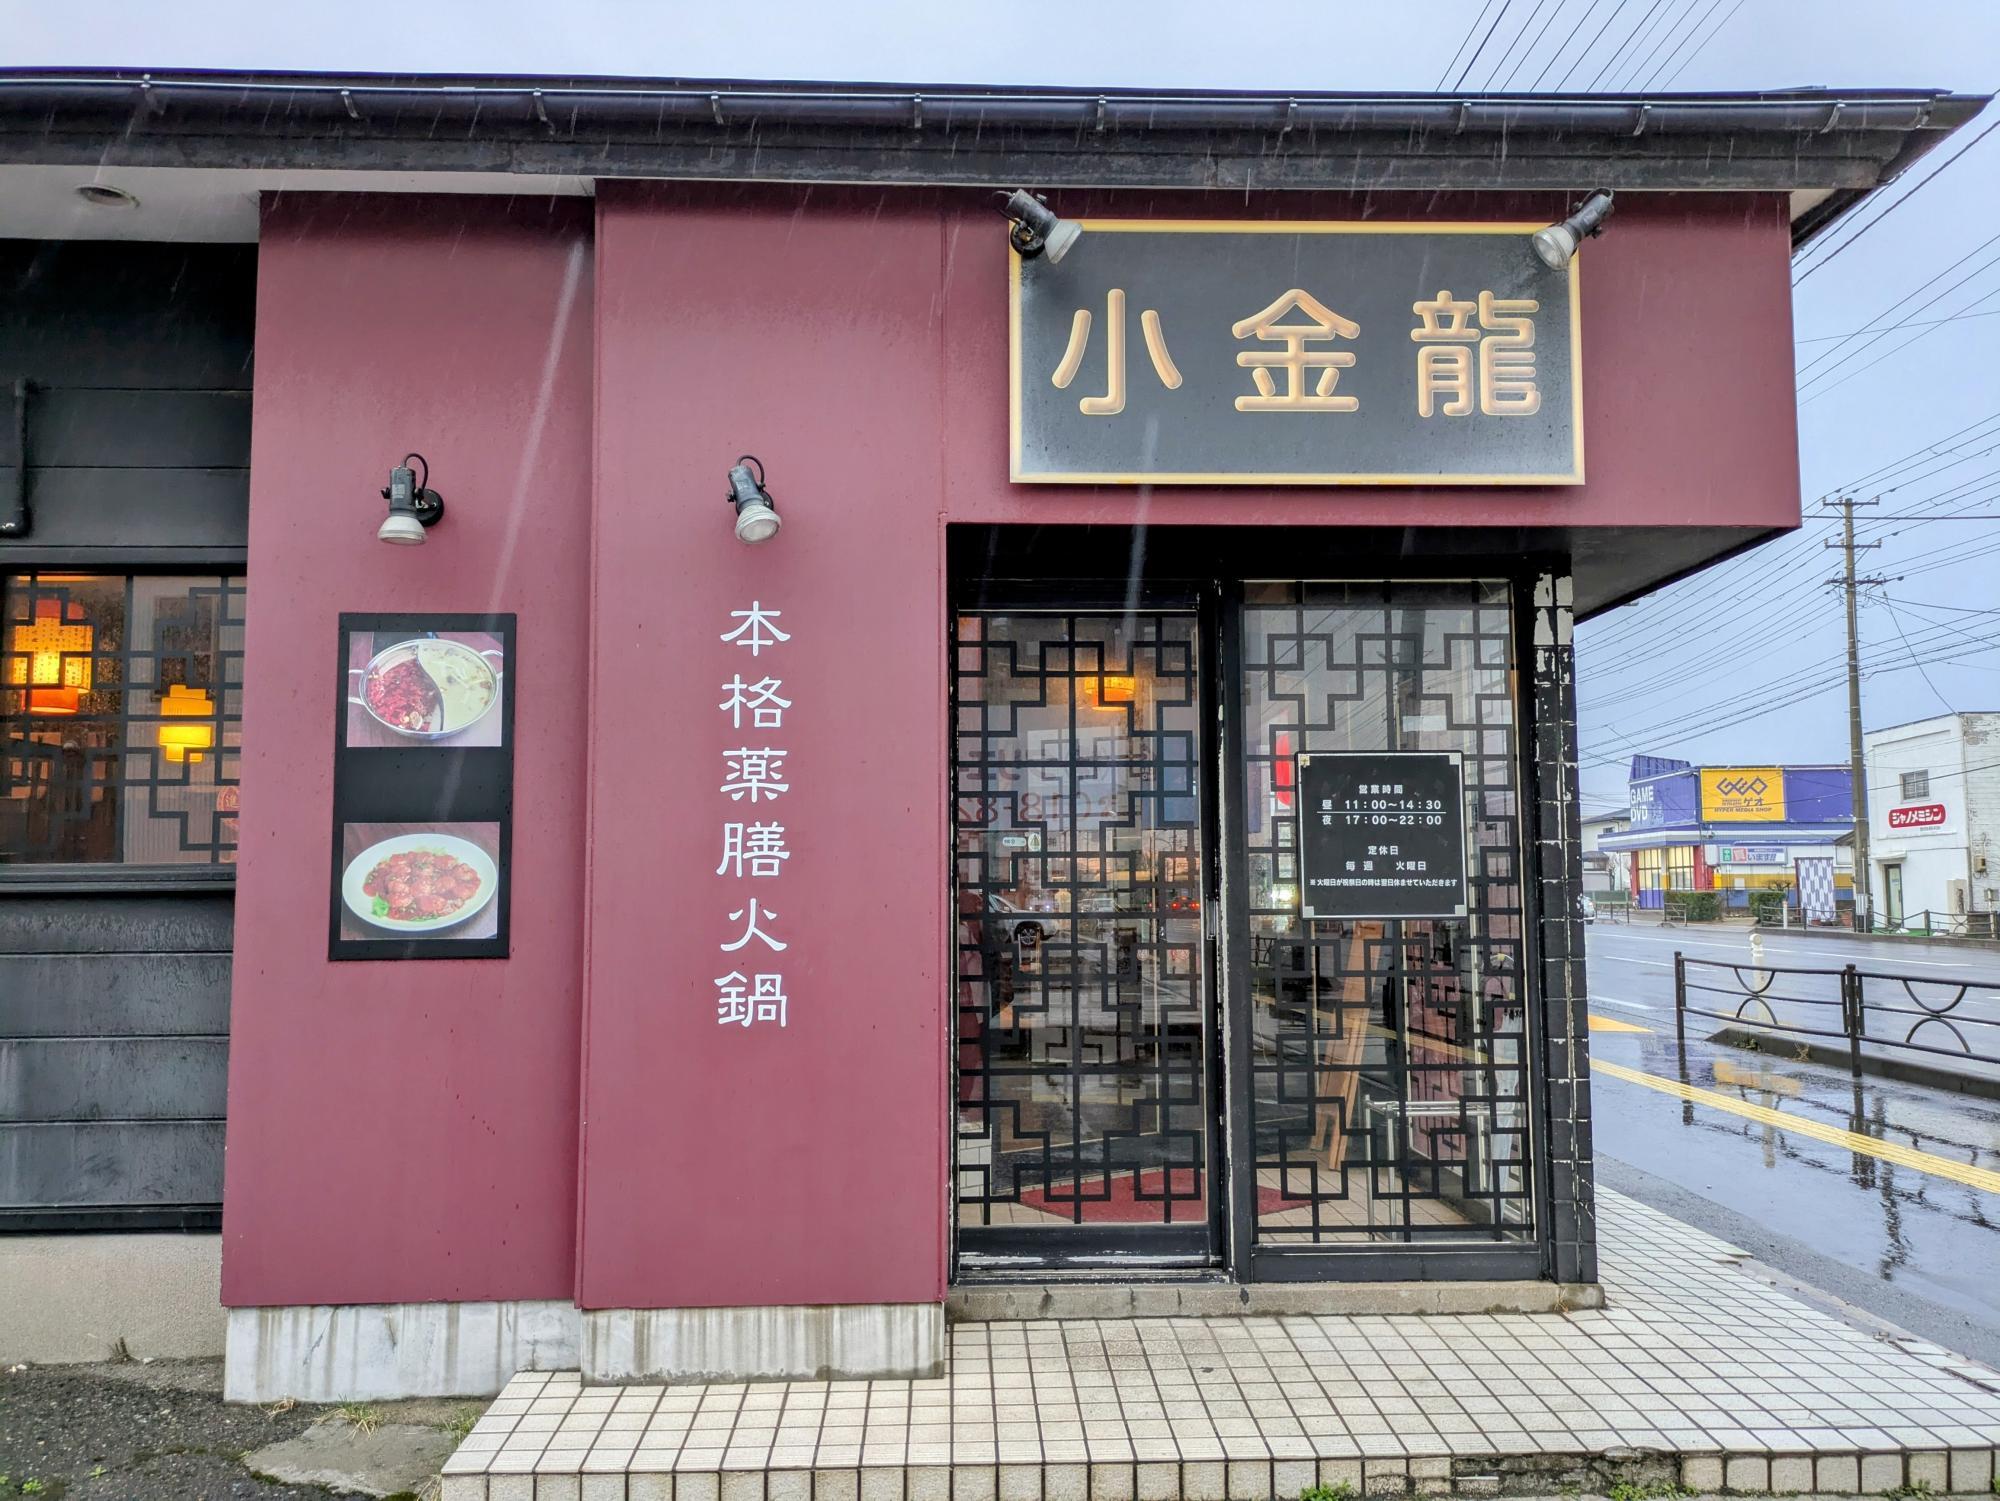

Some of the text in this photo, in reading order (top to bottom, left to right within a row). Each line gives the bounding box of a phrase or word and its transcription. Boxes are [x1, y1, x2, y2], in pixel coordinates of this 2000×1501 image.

[1051, 288, 1542, 418] 小金龍
[1358, 784, 1404, 795] 営業時間
[1631, 785, 1654, 804] GAME
[1322, 799, 1333, 810] 昼
[1744, 797, 1765, 807] ゲオ
[713, 600, 793, 1028] 本格薬膳火鍋
[1631, 805, 1648, 822] DVD
[1891, 808, 1942, 825] ジャノメミシン
[1322, 815, 1332, 826] 夜
[1367, 845, 1399, 856] 定休日
[1395, 861, 1427, 872] 火曜日
